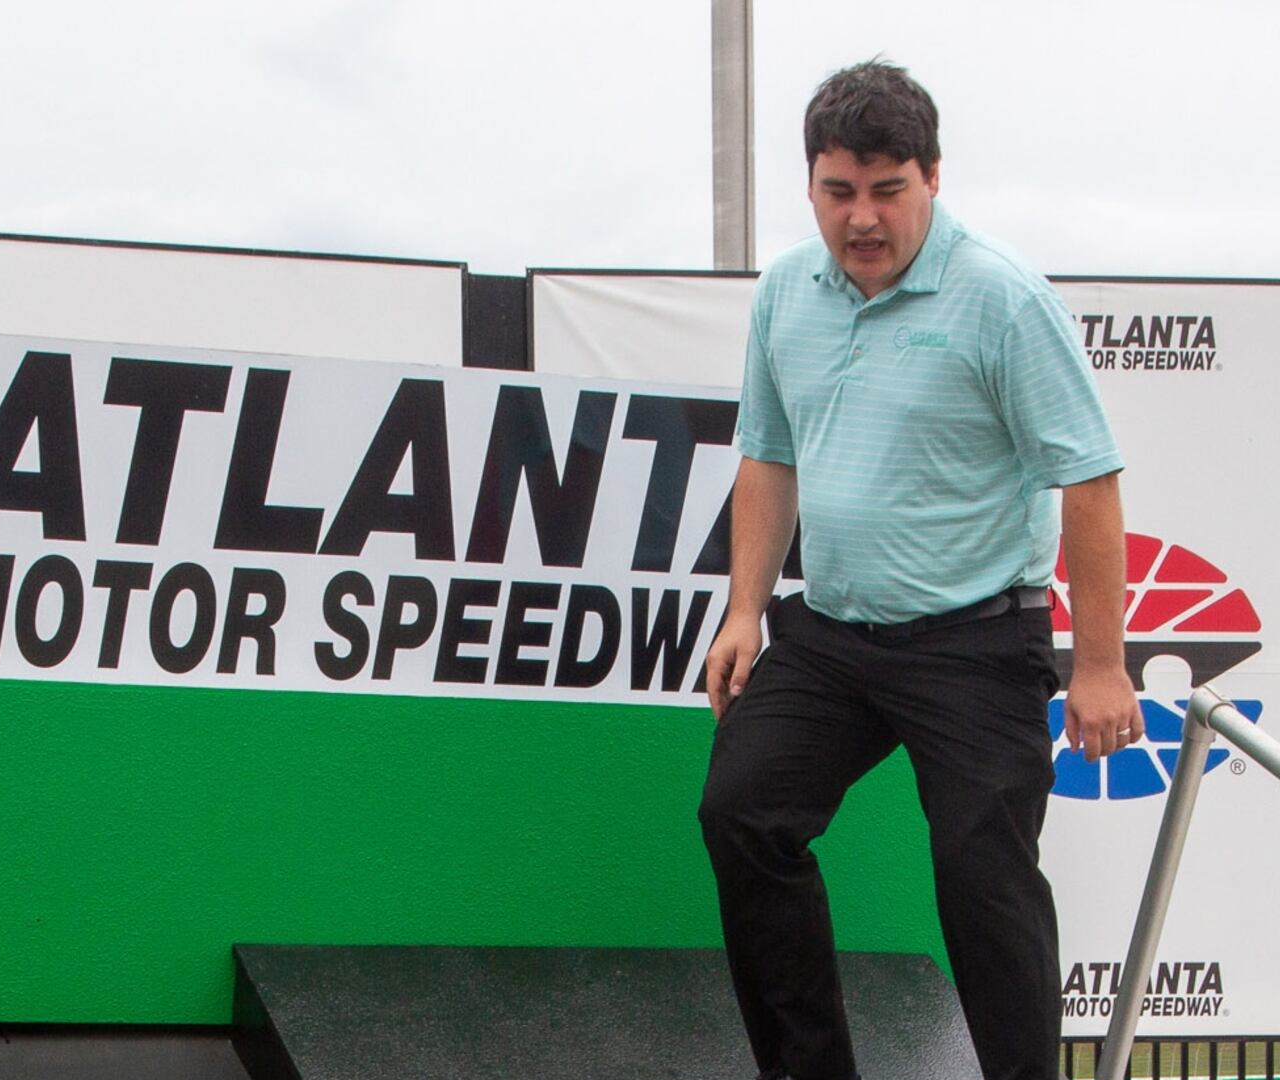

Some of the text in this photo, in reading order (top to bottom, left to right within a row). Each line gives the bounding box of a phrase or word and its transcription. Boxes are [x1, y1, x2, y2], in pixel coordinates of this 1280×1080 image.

[1073, 315, 1216, 349] TLANTA
[1121, 350, 1217, 370] SPEEDWAY
[313, 570, 732, 693] SPEEDW
[1062, 962, 1224, 995] ATLNTA
[1062, 997, 1224, 1017] MOTO PEEDWAY
